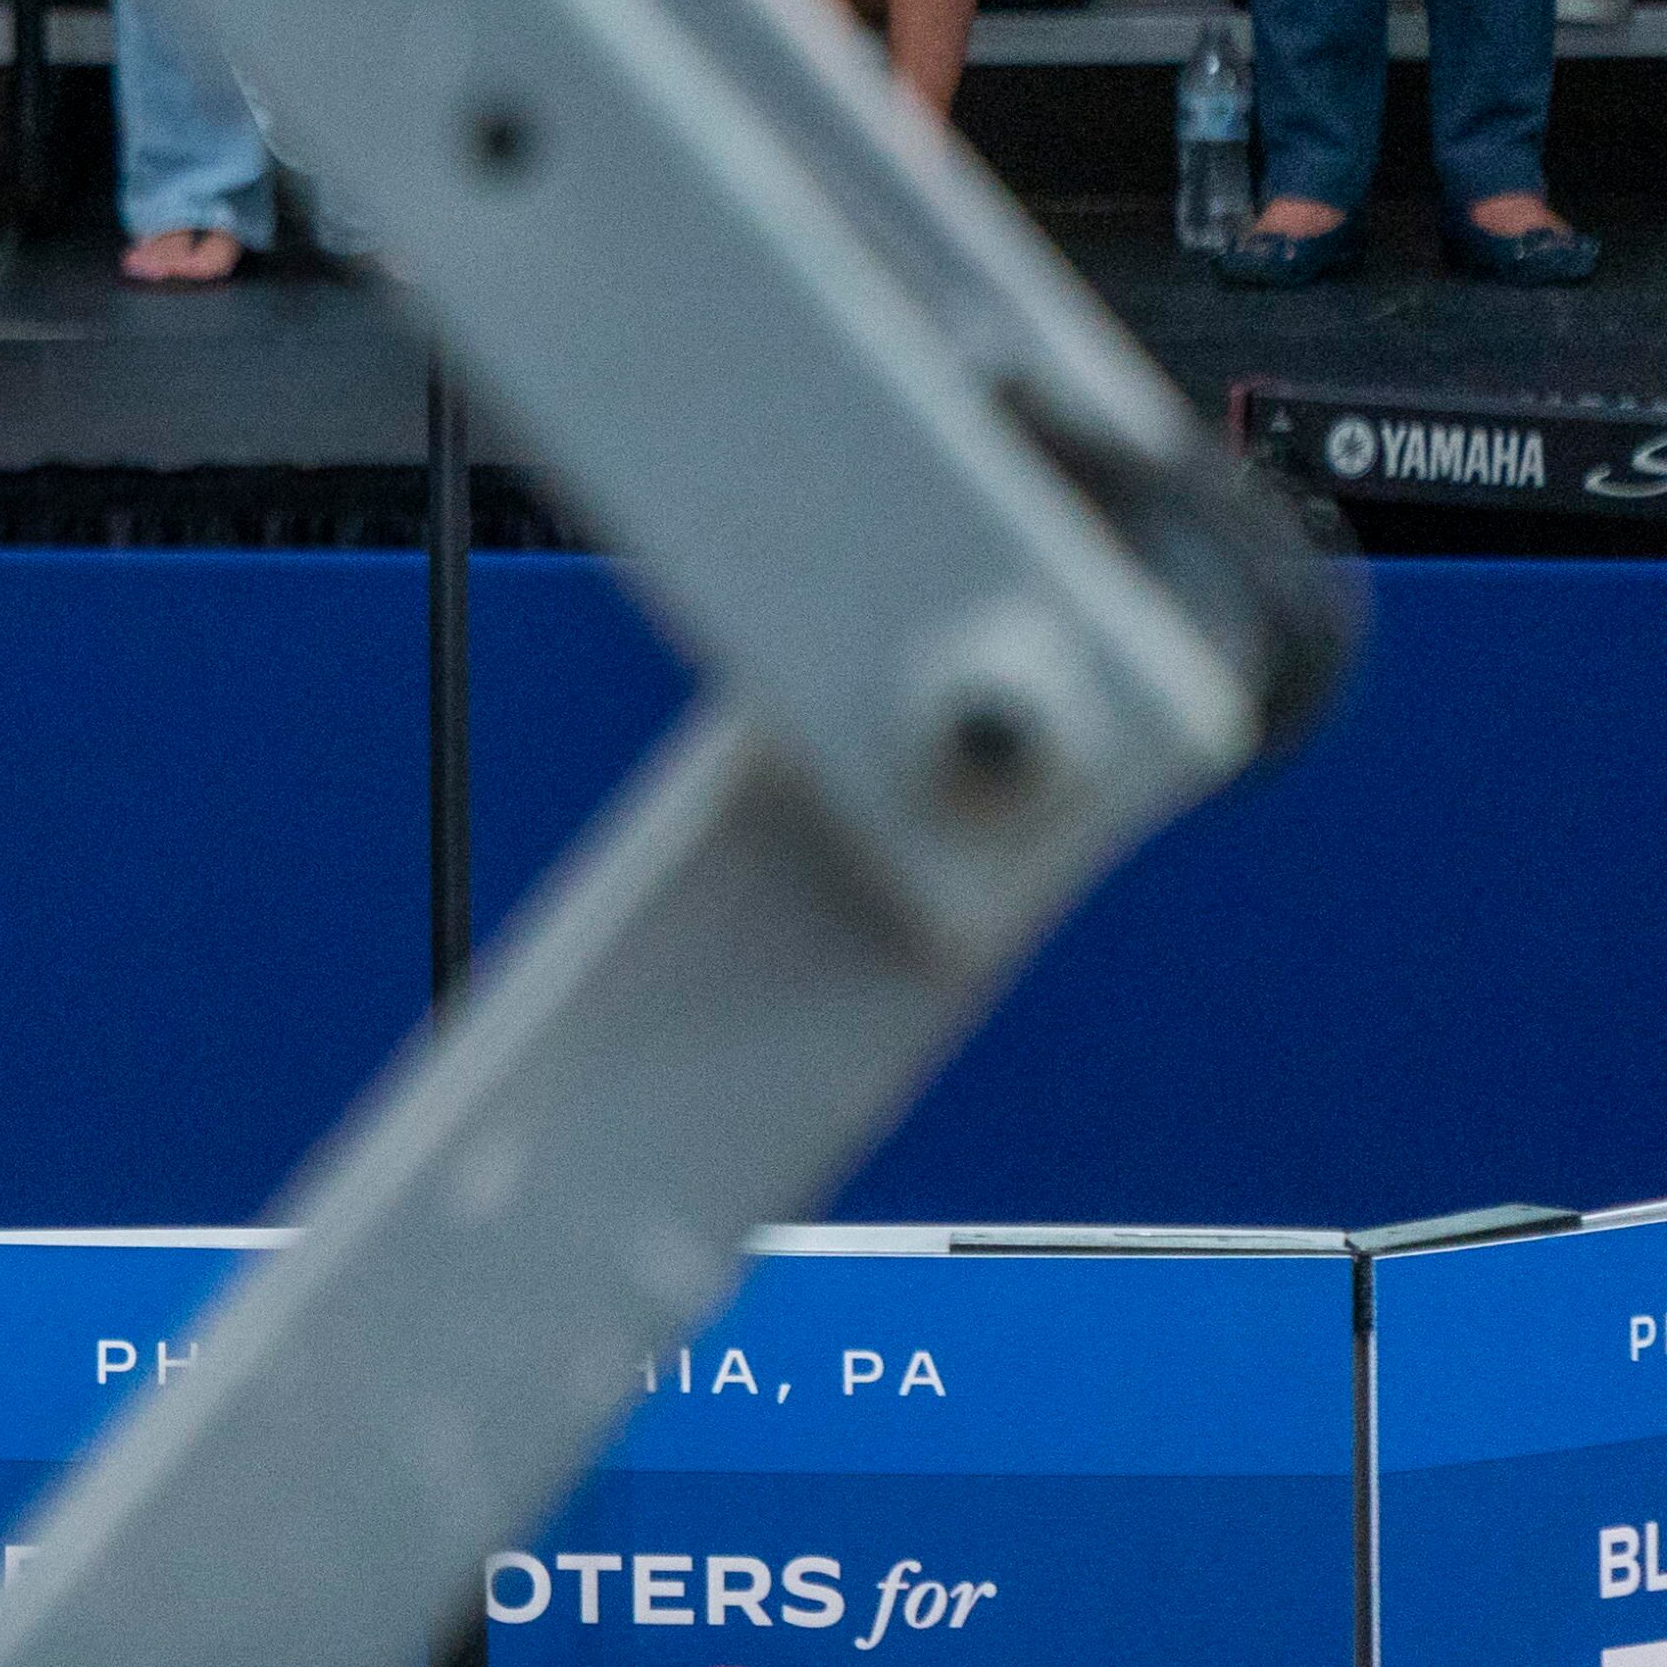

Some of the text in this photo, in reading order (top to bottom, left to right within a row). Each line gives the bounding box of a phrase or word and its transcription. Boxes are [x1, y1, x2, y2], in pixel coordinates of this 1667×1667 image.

[1380, 420, 1546, 487] YAMAHA
[841, 1349, 947, 1398] PA
[485, 1551, 998, 1652] OTERS for
